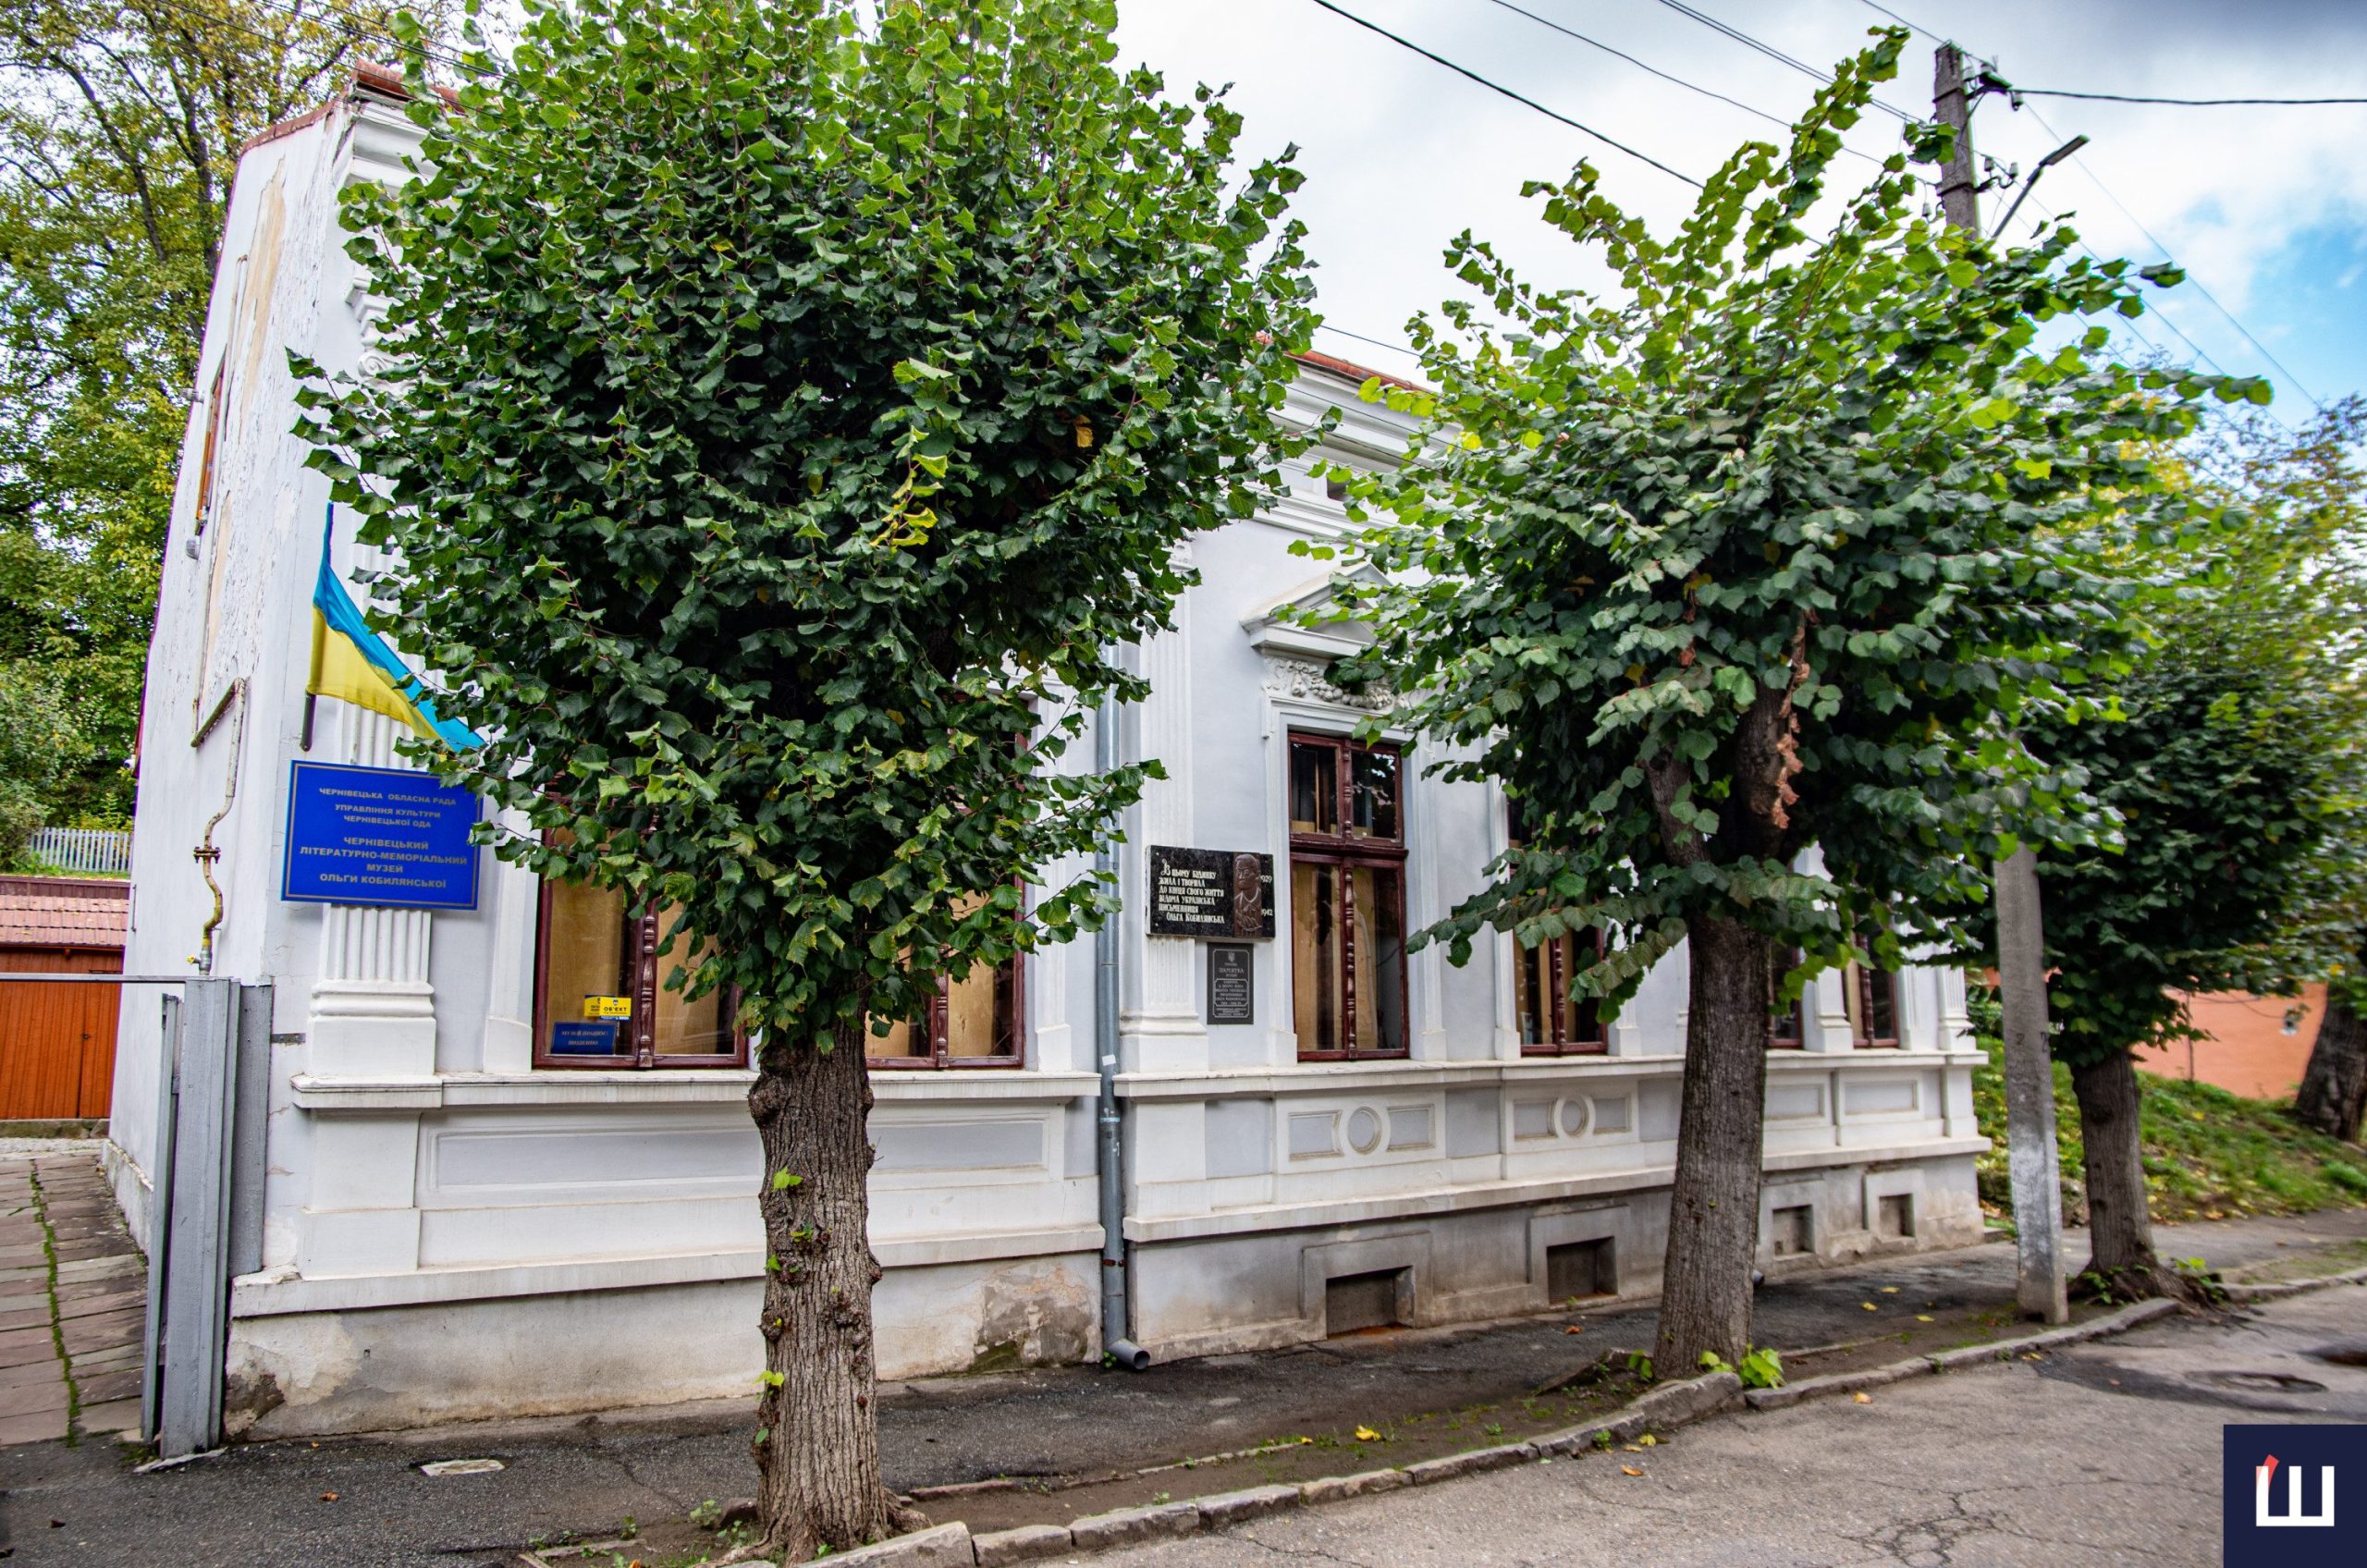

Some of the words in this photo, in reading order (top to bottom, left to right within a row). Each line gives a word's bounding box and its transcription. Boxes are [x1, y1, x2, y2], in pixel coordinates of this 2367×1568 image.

[319, 788, 383, 800] ЧЕРНІВЕЦЬКА
[387, 793, 430, 803] ОБЛАСНА
[433, 797, 457, 806] РАДА
[335, 803, 393, 815] УПРАВЛІННЯ
[396, 808, 441, 818] КУЛЬТУРИ
[344, 815, 411, 827] ЧЕРНІВЕЦЬКОЇ
[412, 820, 431, 828] ОДА
[344, 837, 429, 851] ЧЕРНІВЕЦЬКИЙ
[300, 846, 467, 865] ЛІТЕРАТУРНО-МЕМОРІАЛЬНИЙ
[366, 863, 403, 874] МУЗЕЙ
[319, 873, 358, 883] ОЛЬГИ
[361, 876, 447, 888] КОБИЛЯНСЬКОЇ
